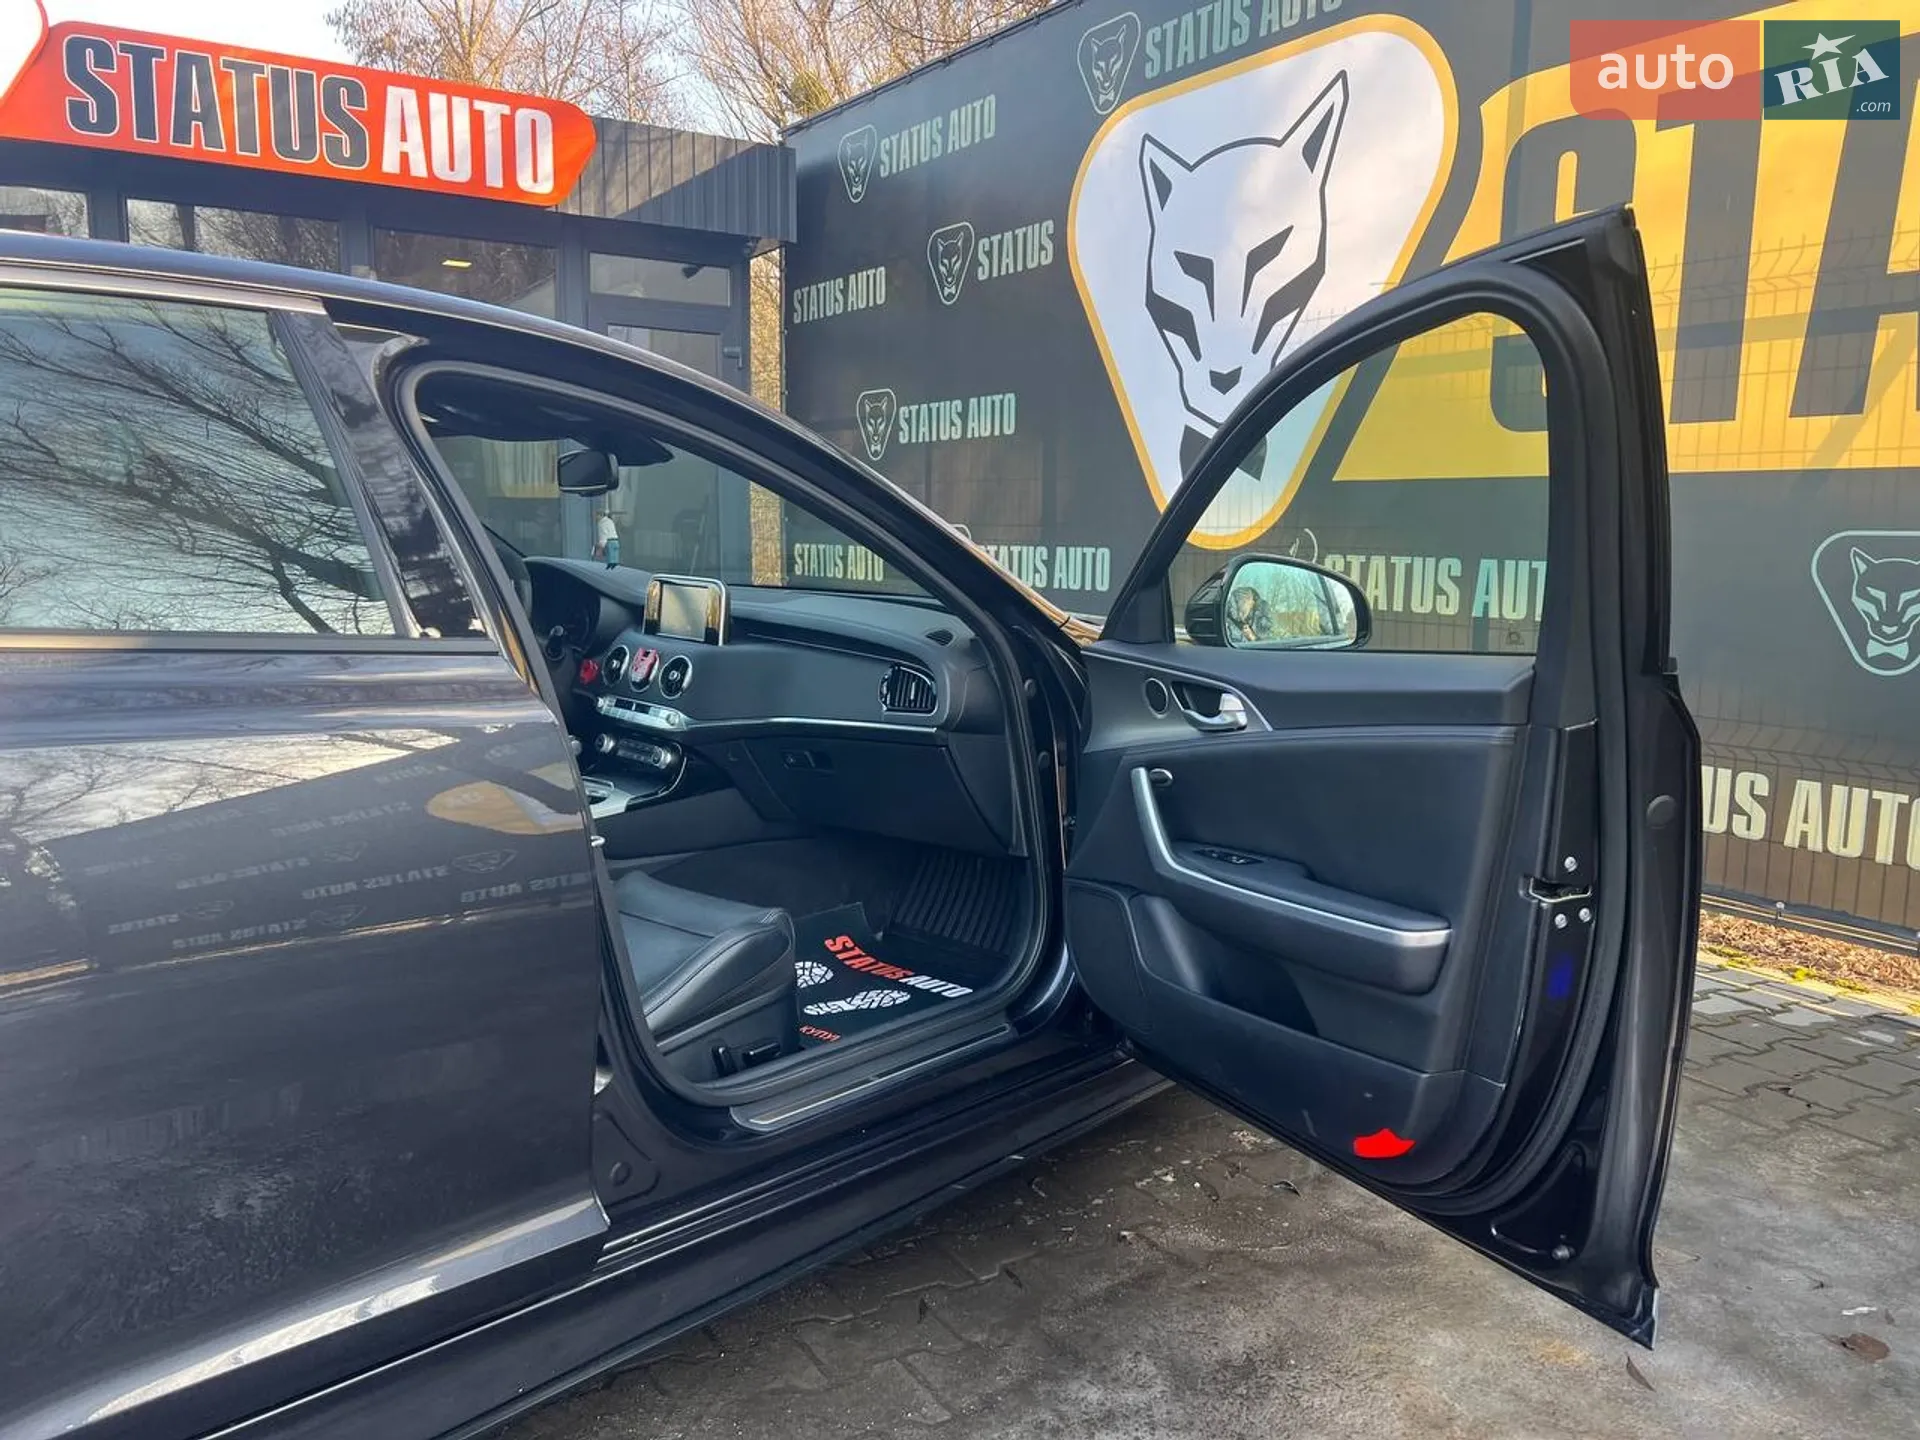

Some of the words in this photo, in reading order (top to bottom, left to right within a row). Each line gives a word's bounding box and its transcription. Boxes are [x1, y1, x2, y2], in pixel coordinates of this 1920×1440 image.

[1145, 0, 1250, 79] STATUS
[63, 34, 368, 169] STATUS
[381, 85, 555, 195] AUTO
[879, 117, 943, 178] STATUS
[947, 94, 996, 158] AUTO
[977, 219, 1054, 280] STATUS
[793, 277, 846, 324] STATUS
[847, 266, 886, 312] AUTO
[898, 399, 963, 443] STATUS
[967, 393, 1017, 439] AUTO
[794, 543, 844, 579] STATUS
[846, 545, 885, 582] AUTO
[1053, 546, 1111, 592] AUTO
